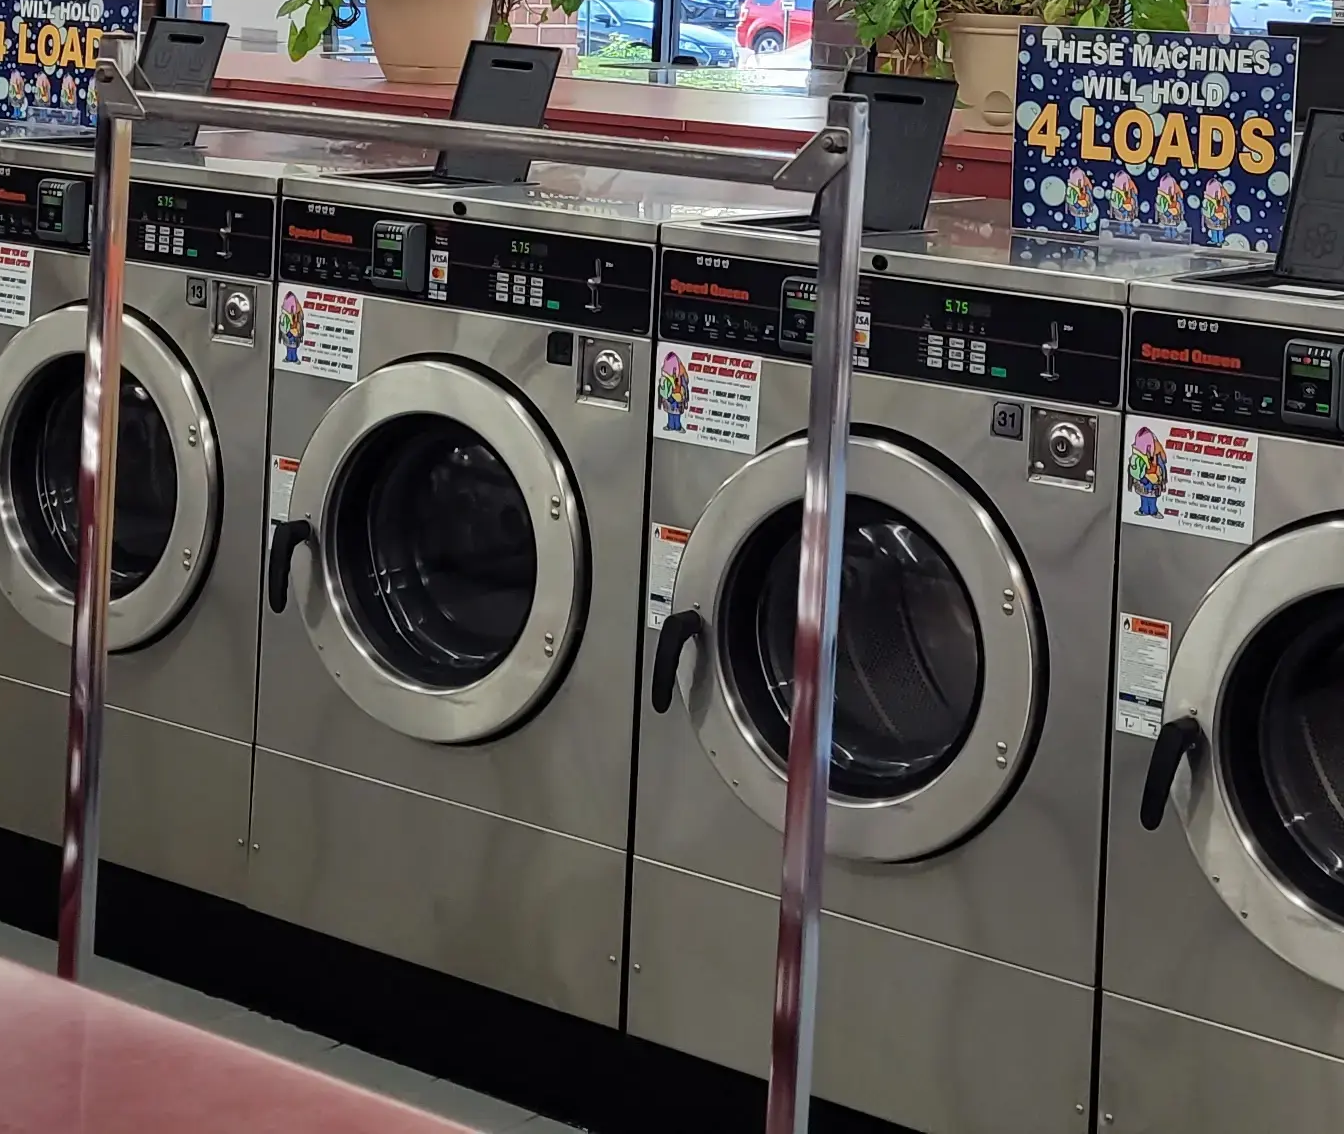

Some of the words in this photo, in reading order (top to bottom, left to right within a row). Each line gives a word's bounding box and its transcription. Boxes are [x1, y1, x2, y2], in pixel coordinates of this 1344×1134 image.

[19, 0, 55, 20] WILL
[60, 1, 102, 23] HOLD
[16, 23, 104, 70] LOAD
[1042, 38, 1125, 67] THESE
[1132, 43, 1271, 76] MACHINES
[1082, 75, 1144, 103] WILL
[1152, 79, 1224, 108] HOLD
[1026, 103, 1063, 157] 4
[1079, 105, 1276, 175] LOADS
[288, 225, 320, 239] Speed
[320, 229, 353, 244] Queen
[431, 253, 448, 264] VISA
[190, 283, 204, 299] 13
[670, 278, 708, 295] Speed
[709, 282, 750, 302] Queen
[1141, 342, 1190, 363] Speed
[1191, 349, 1241, 369] Queen
[997, 410, 1016, 429] 31
[1225, 448, 1254, 462] OPTION
